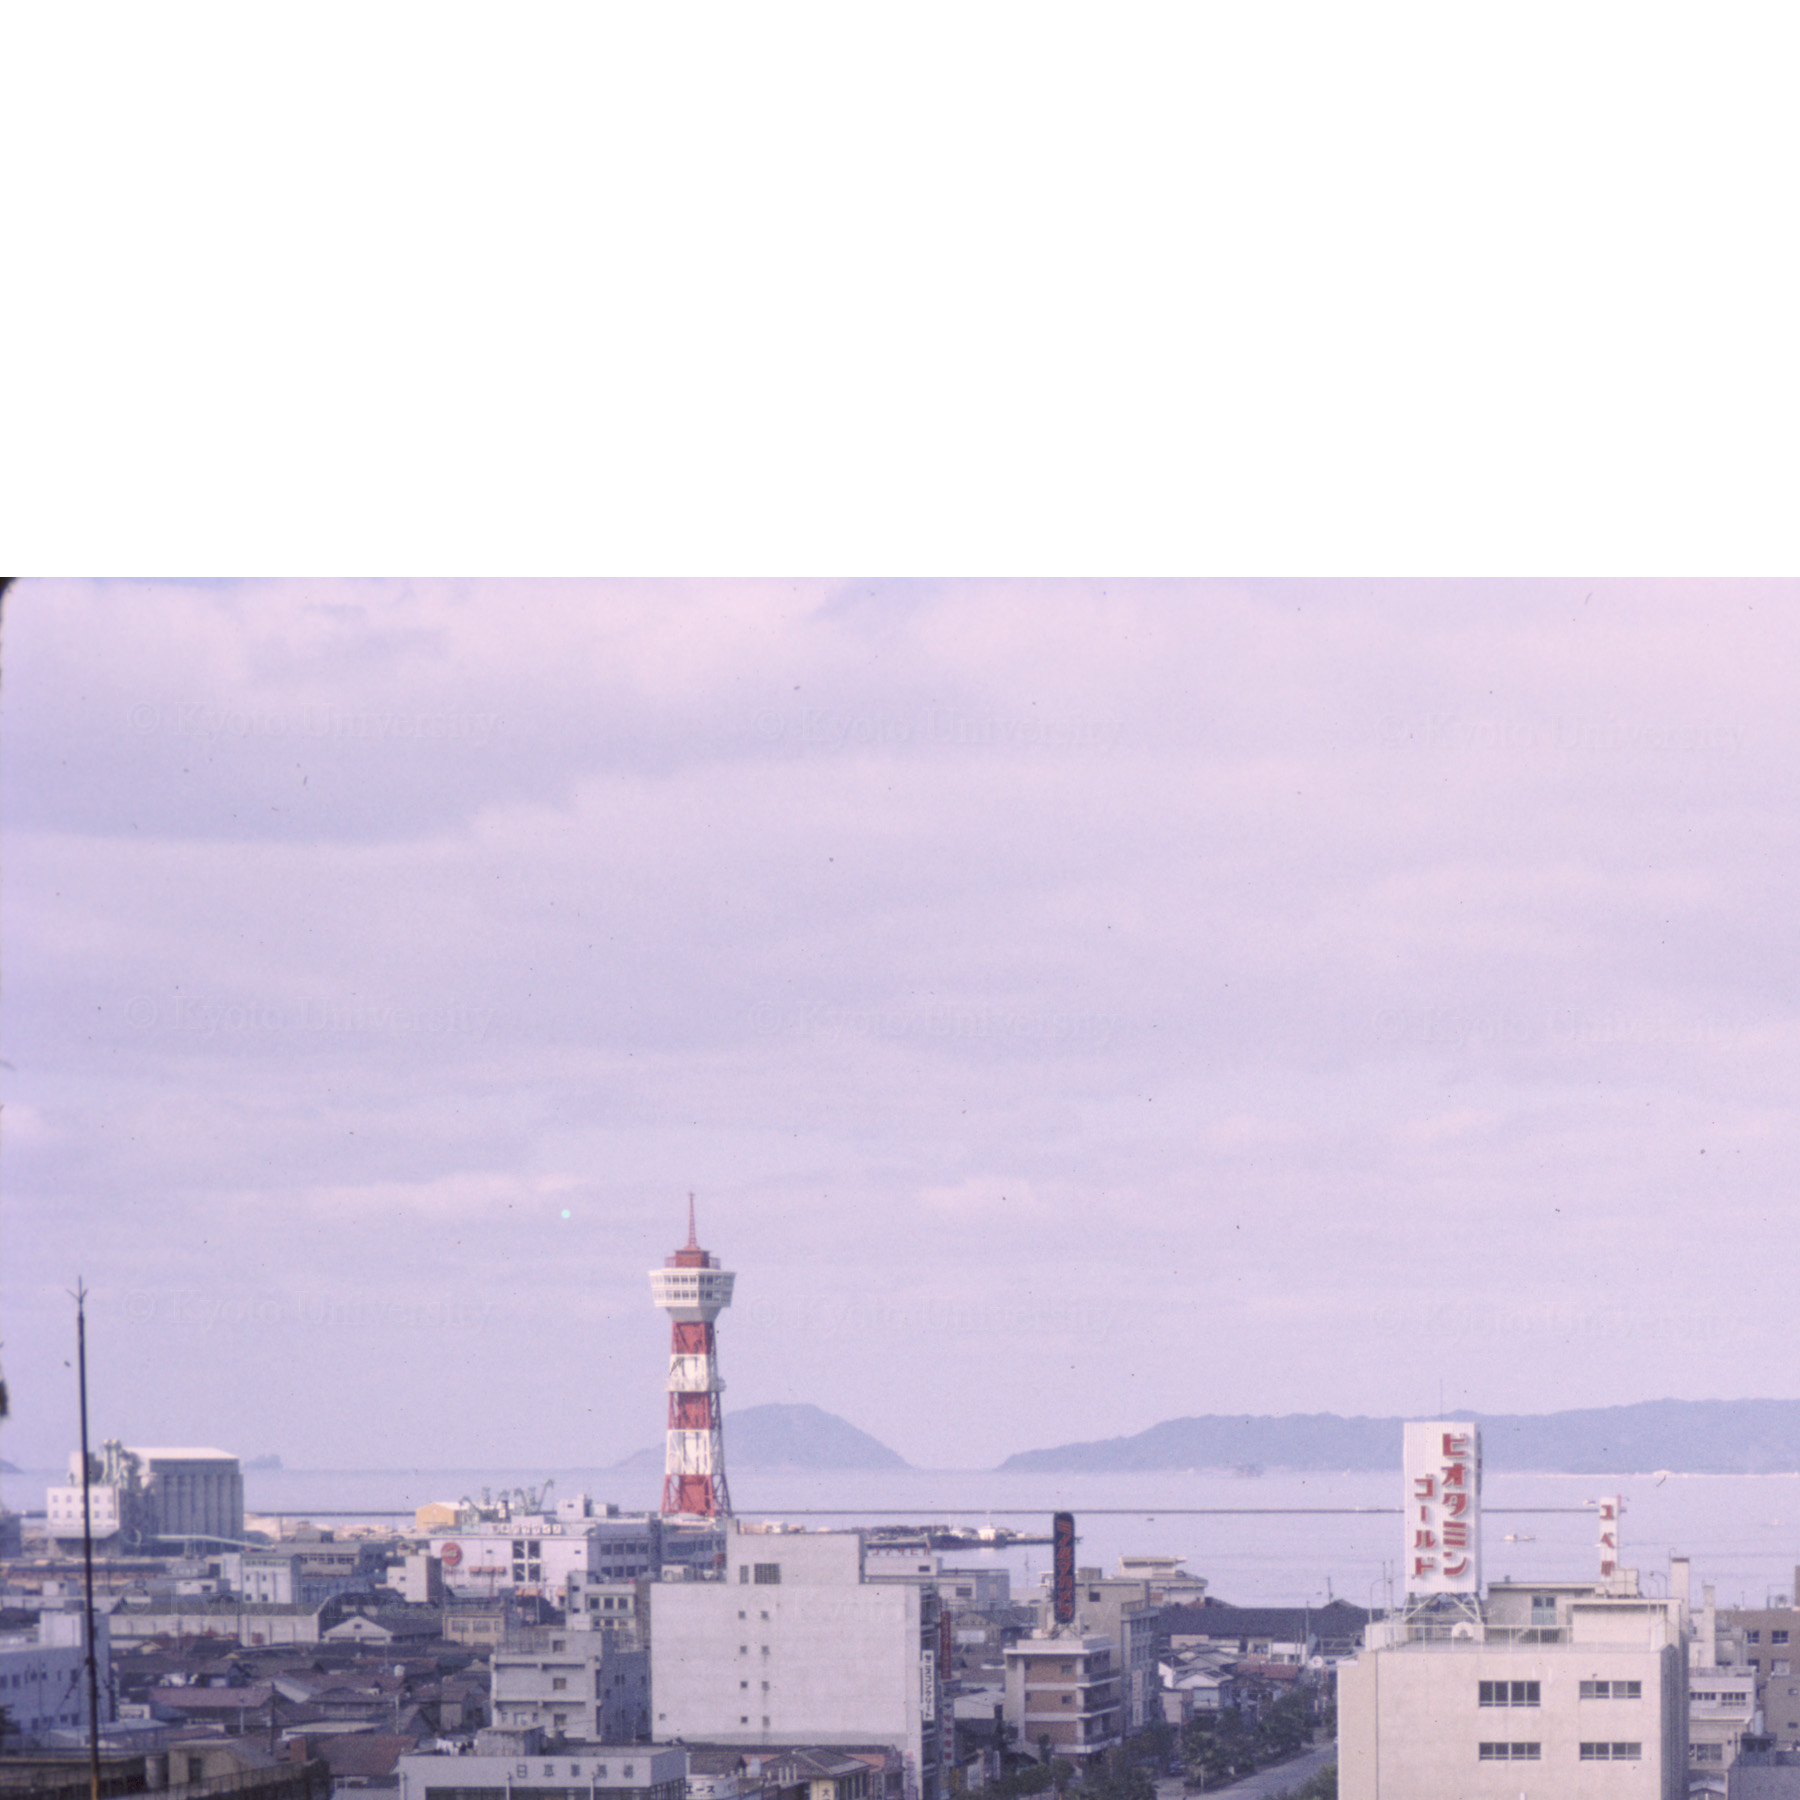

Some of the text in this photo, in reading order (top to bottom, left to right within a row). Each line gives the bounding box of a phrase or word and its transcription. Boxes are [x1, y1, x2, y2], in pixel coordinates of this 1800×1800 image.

[1414, 1473, 1436, 1576] ゴールド
[1441, 1432, 1467, 1576] ビオタミン
